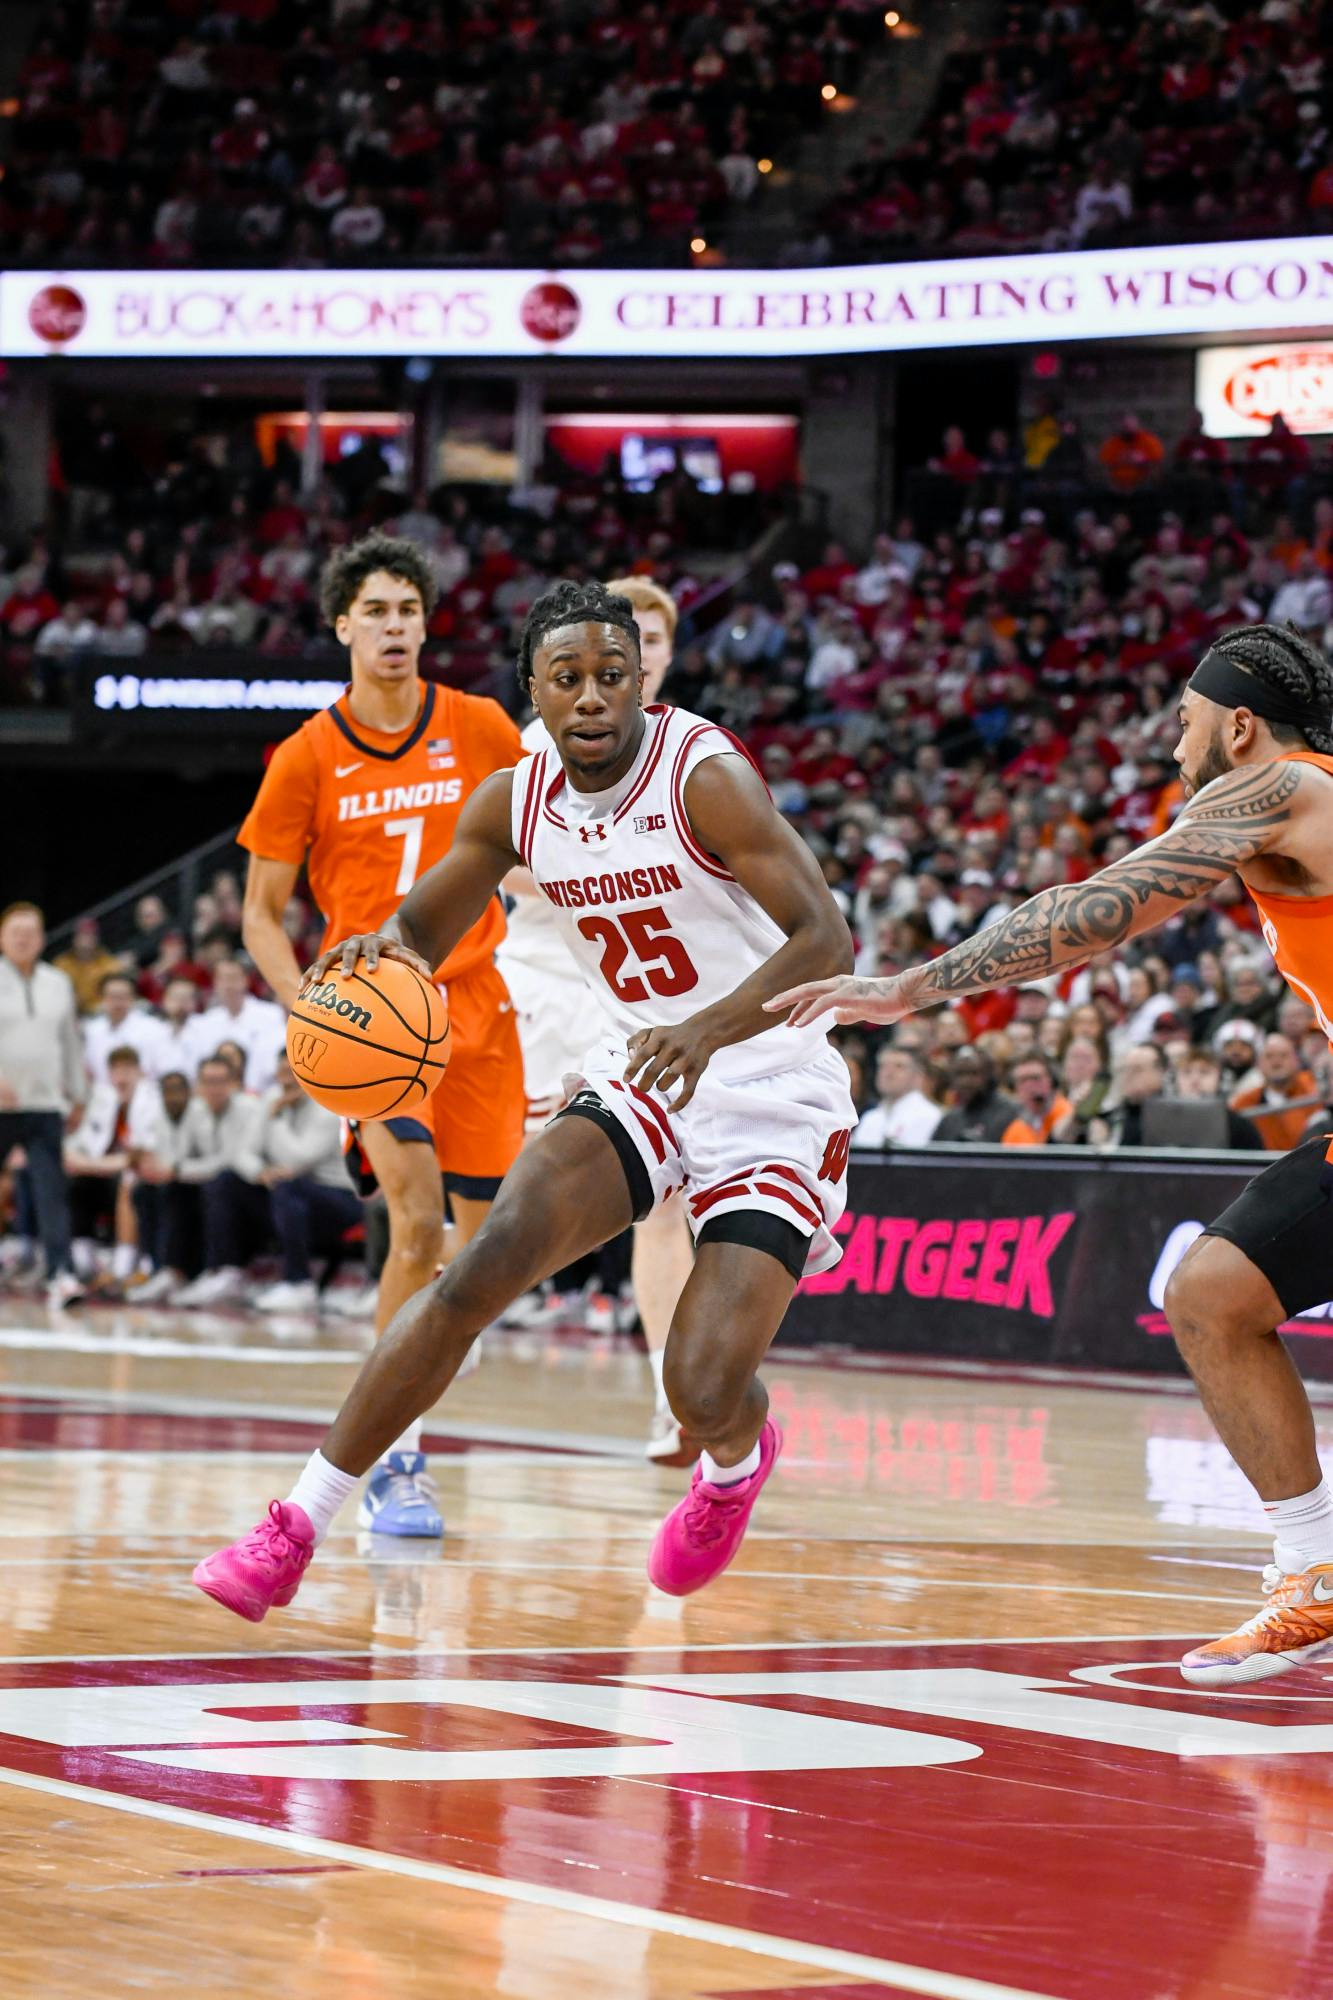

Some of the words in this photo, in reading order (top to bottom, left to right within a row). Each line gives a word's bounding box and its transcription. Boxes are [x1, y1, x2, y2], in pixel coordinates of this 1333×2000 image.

[114, 290, 251, 338] BUCK
[616, 274, 1075, 330] CELEBRATING
[338, 778, 463, 822] ILLINOIS
[384, 816, 424, 896] 7
[539, 863, 683, 908] WISCONSIN
[577, 906, 699, 1003] 25
[292, 1032, 328, 1073] W
[817, 1129, 850, 1184] W
[793, 1210, 1078, 1319] EATGEEK
